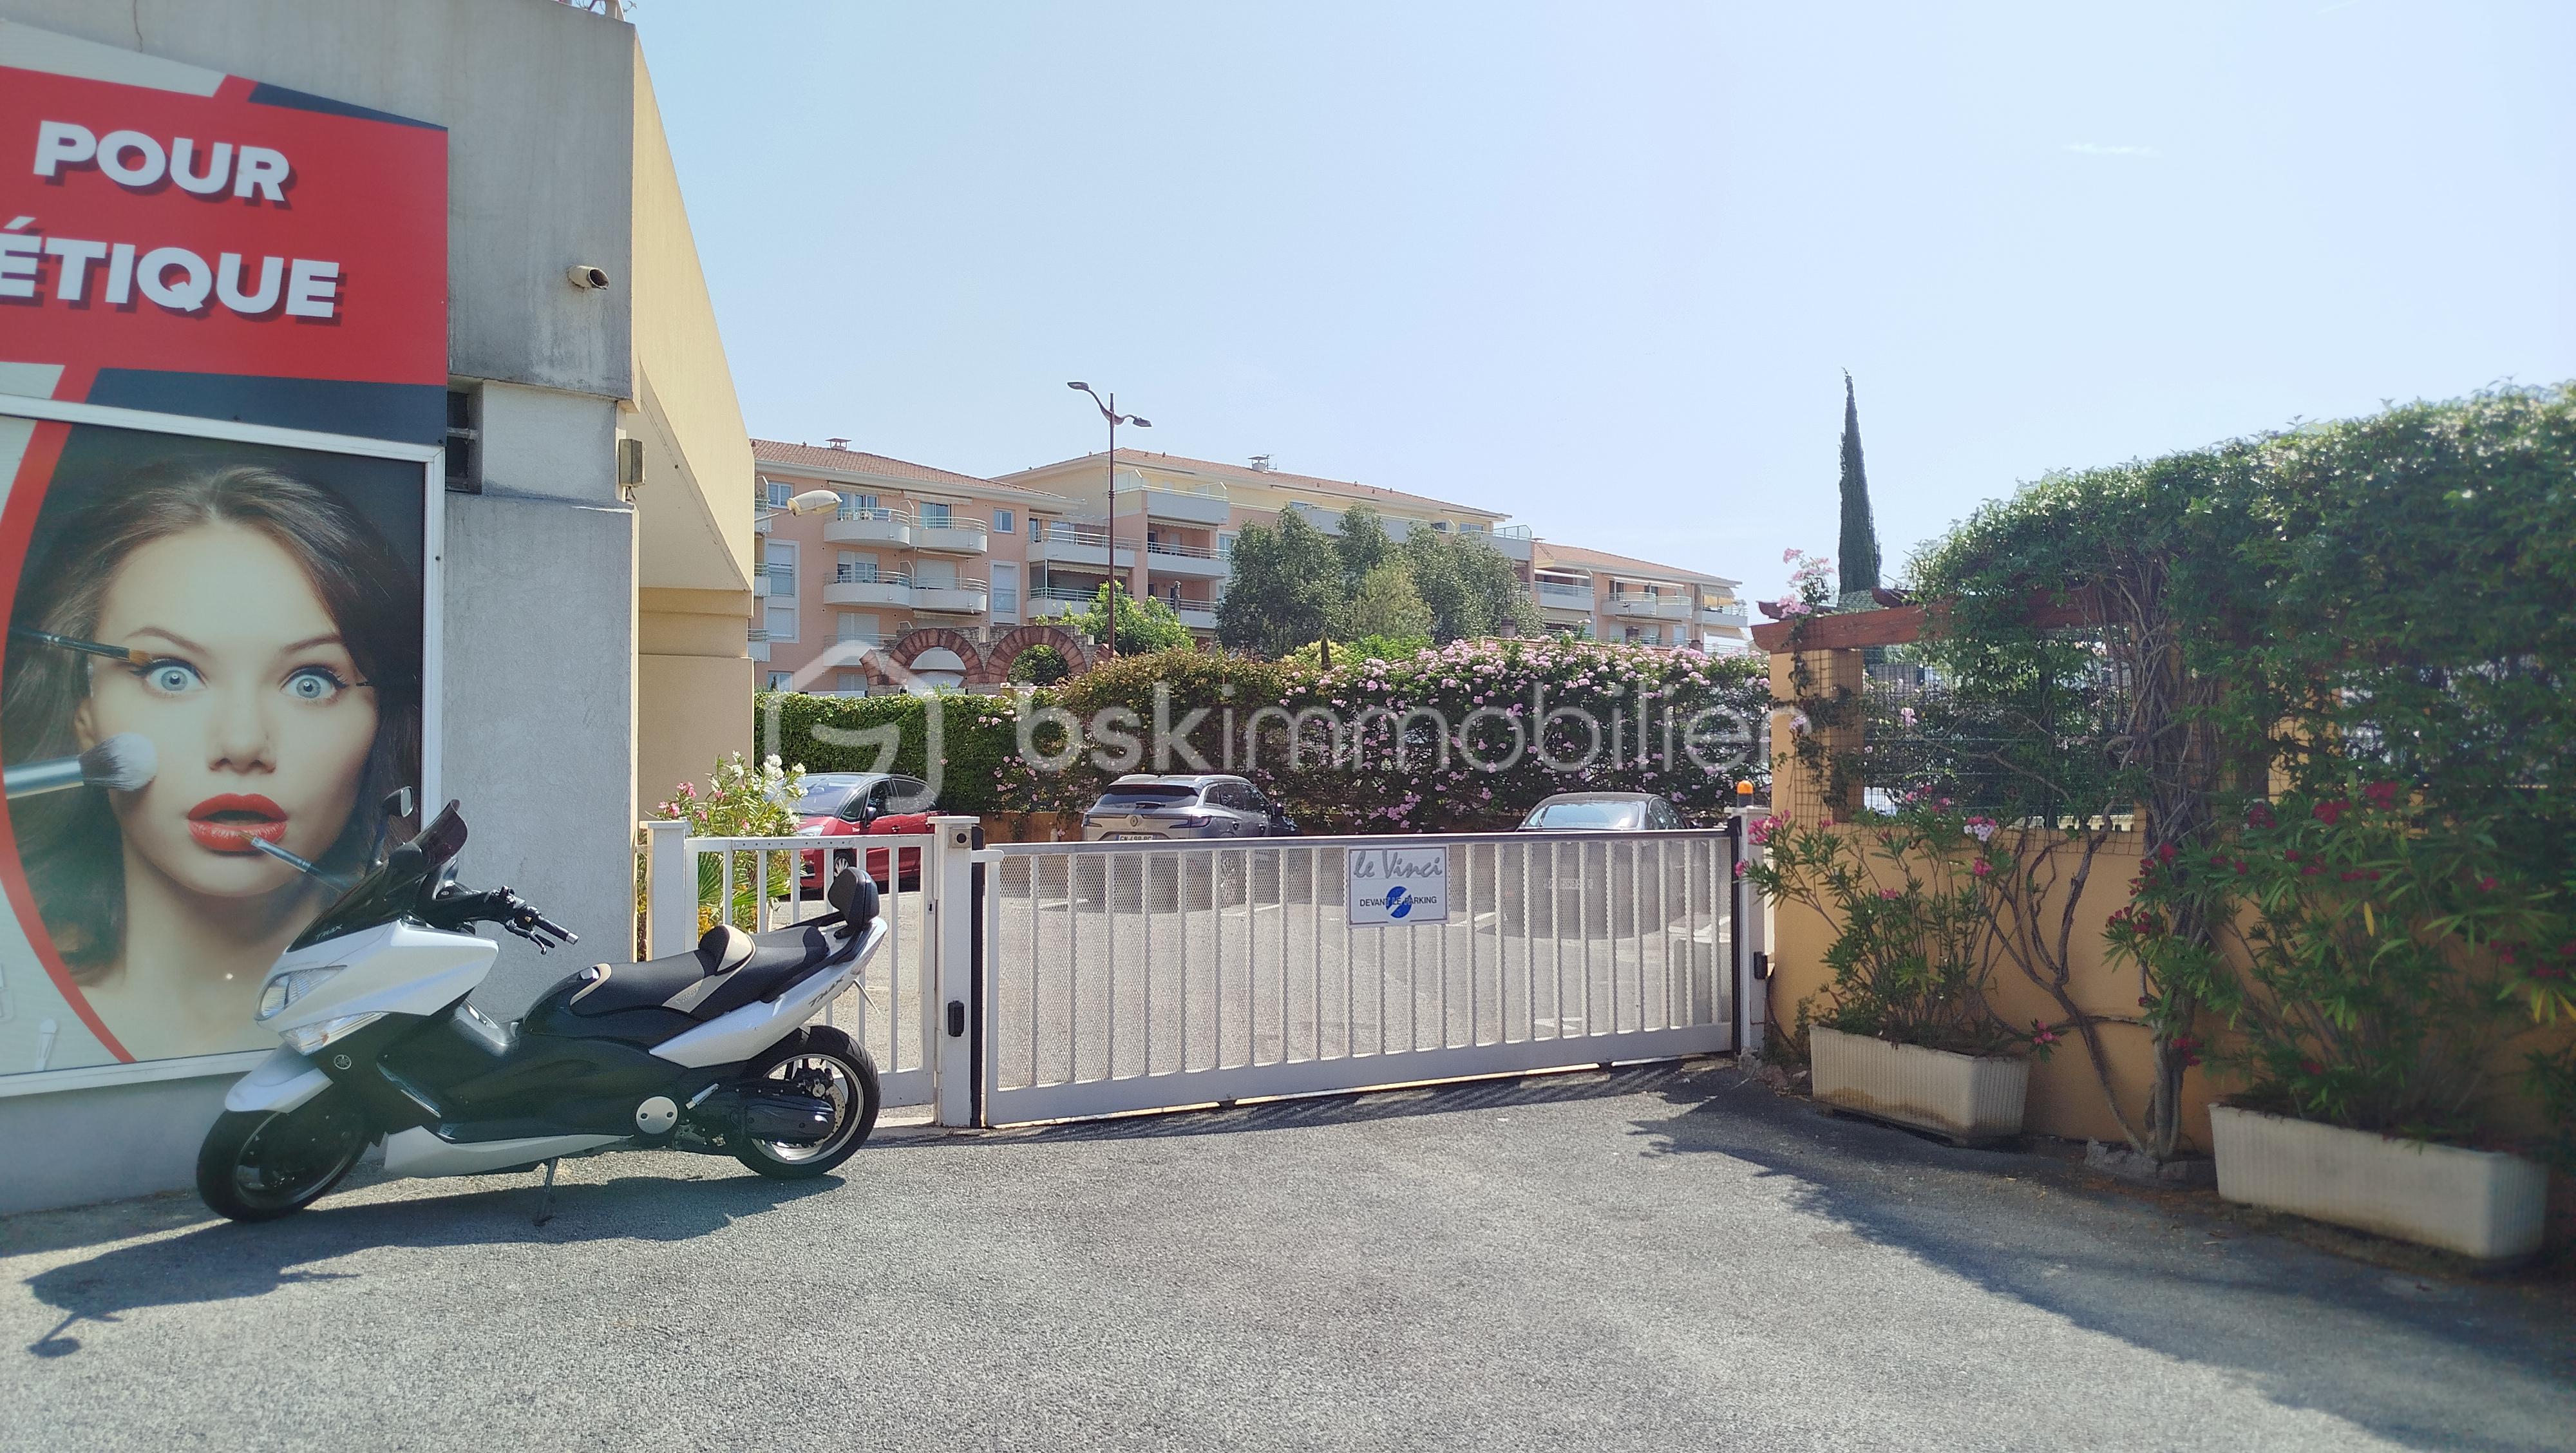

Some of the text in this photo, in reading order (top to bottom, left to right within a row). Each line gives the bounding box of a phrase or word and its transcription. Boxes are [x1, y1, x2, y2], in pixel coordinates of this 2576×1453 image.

[33, 120, 290, 202] POUR
[1354, 849, 1443, 878] le Vinci
[1359, 896, 1437, 907] DEVANT LE PARKING
